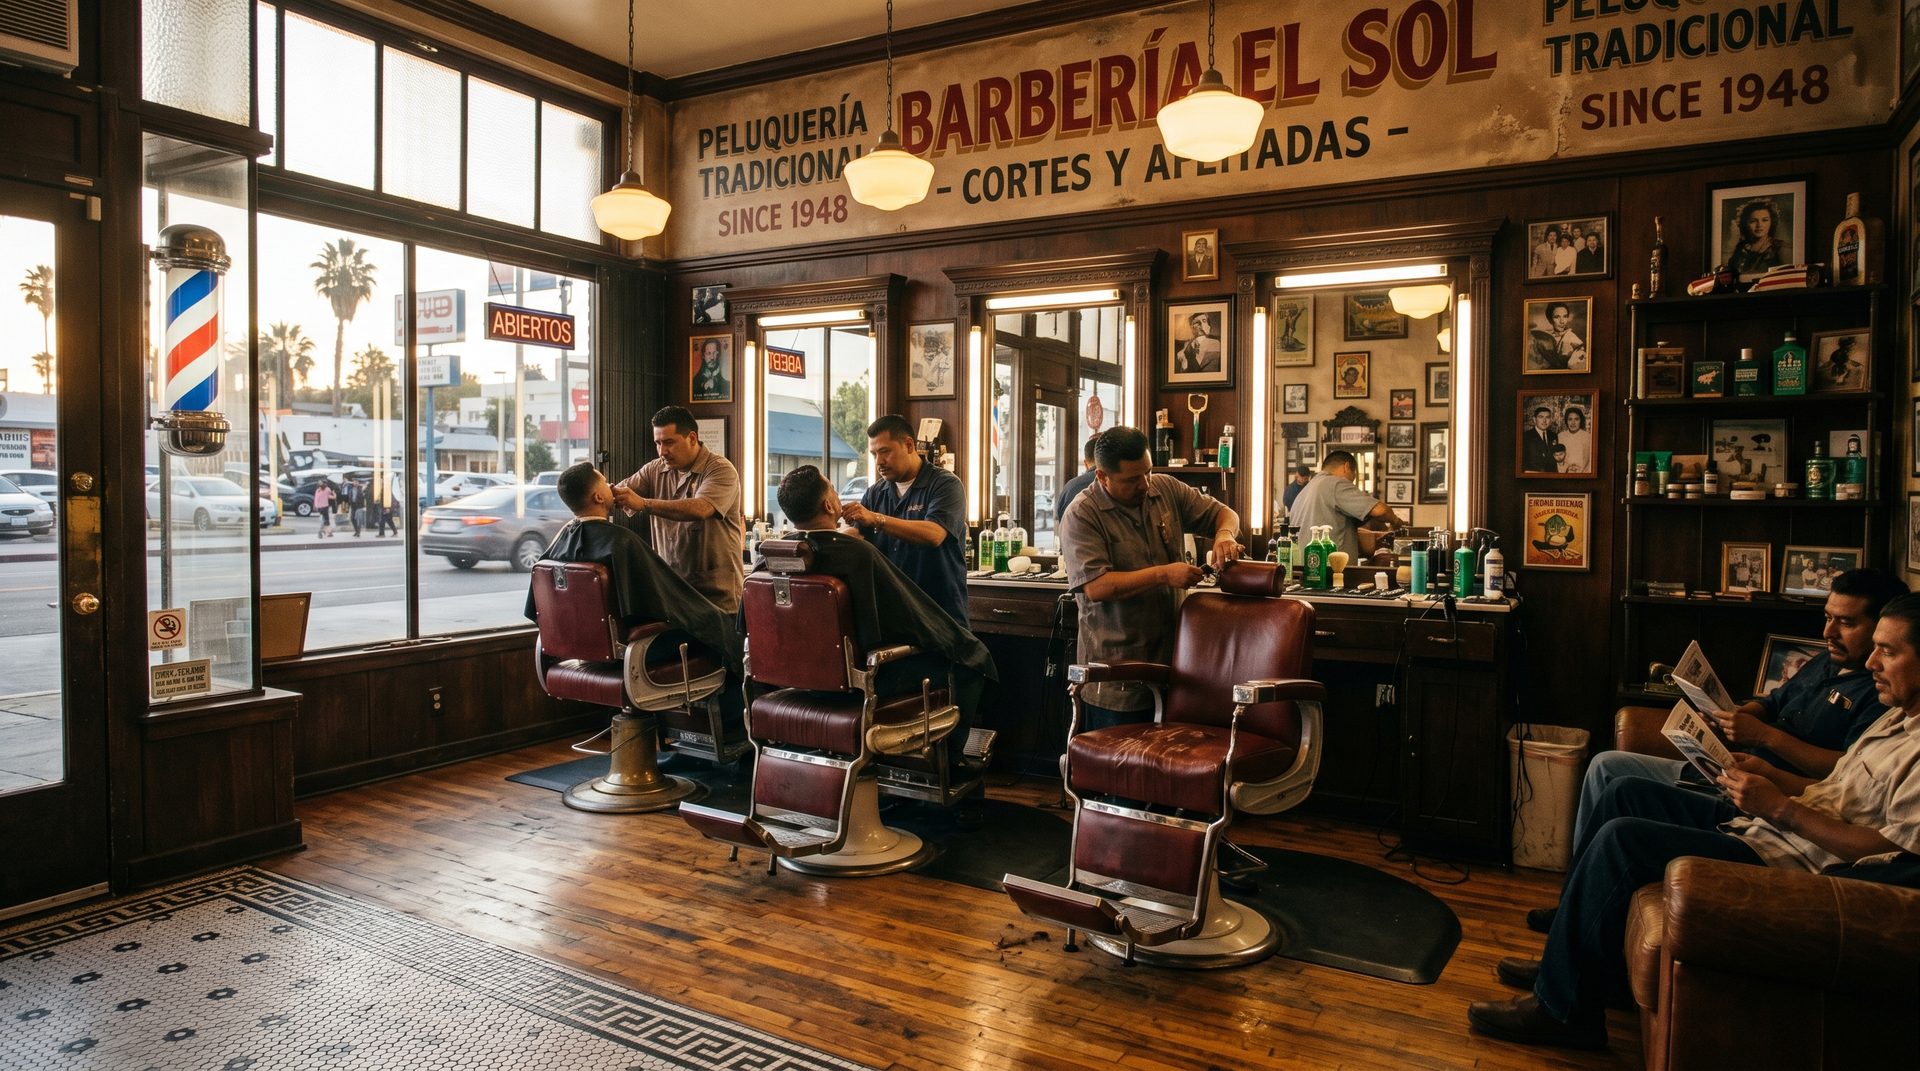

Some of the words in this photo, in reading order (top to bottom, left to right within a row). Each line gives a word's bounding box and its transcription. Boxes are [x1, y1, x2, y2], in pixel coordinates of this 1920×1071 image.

[1544, 0, 1854, 77] TRADICIONAL
[897, 27, 1203, 158] BARBERÍA
[1233, 22, 1320, 109] EL
[1341, 0, 1498, 97] SOL
[1581, 80, 1702, 132] SINCE
[1719, 64, 1830, 114] 1948
[697, 93, 868, 162] PELUQUERÍA
[962, 153, 1092, 205] CORTES
[1105, 147, 1131, 188] Y
[718, 203, 783, 238] SINCE
[791, 194, 849, 229] 1948
[492, 310, 572, 344] ABIERTOS
